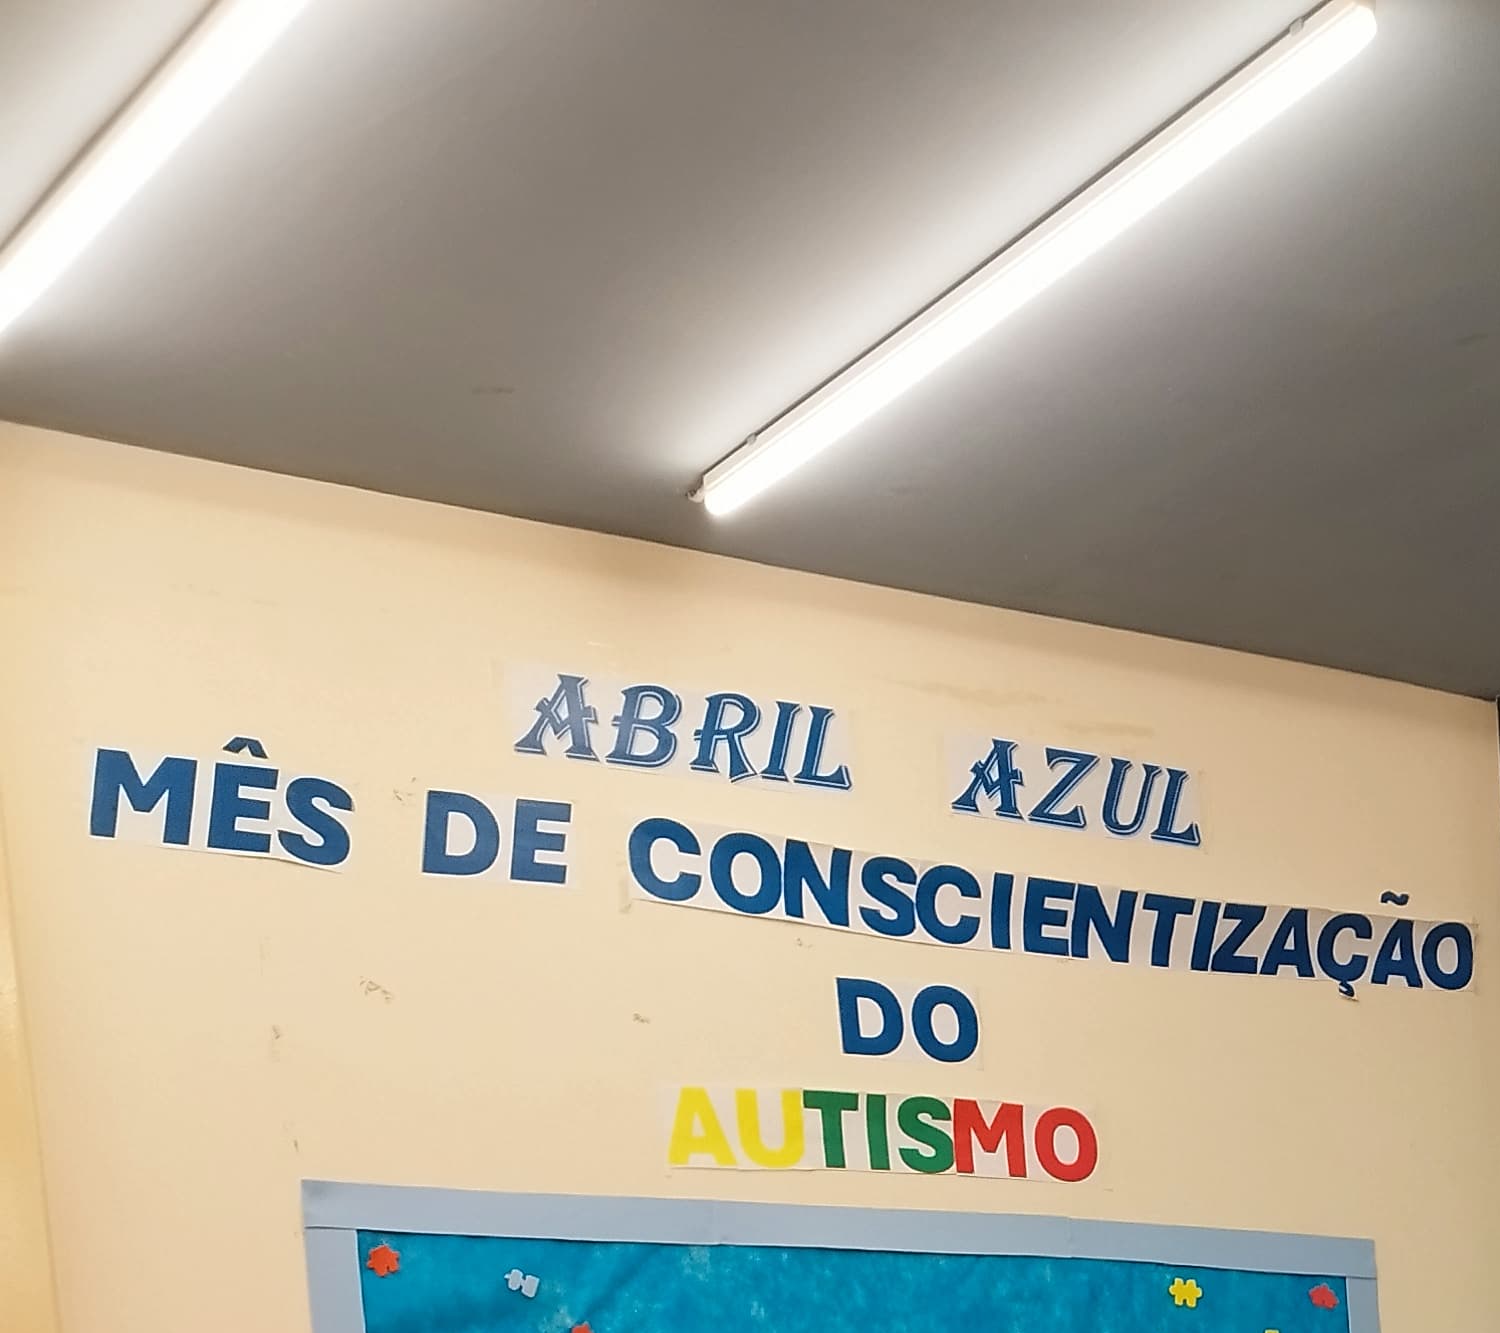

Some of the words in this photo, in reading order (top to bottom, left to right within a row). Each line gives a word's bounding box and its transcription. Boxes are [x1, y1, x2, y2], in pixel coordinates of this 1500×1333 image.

[514, 673, 852, 790] ABRIL
[951, 738, 1201, 846] AZUL
[89, 736, 356, 867] MÊS
[421, 790, 573, 885] DE
[627, 817, 1474, 999] CONSCIENTIZAÇÃO
[835, 977, 980, 1064] DO
[667, 1086, 1098, 1183] AUTISMO
